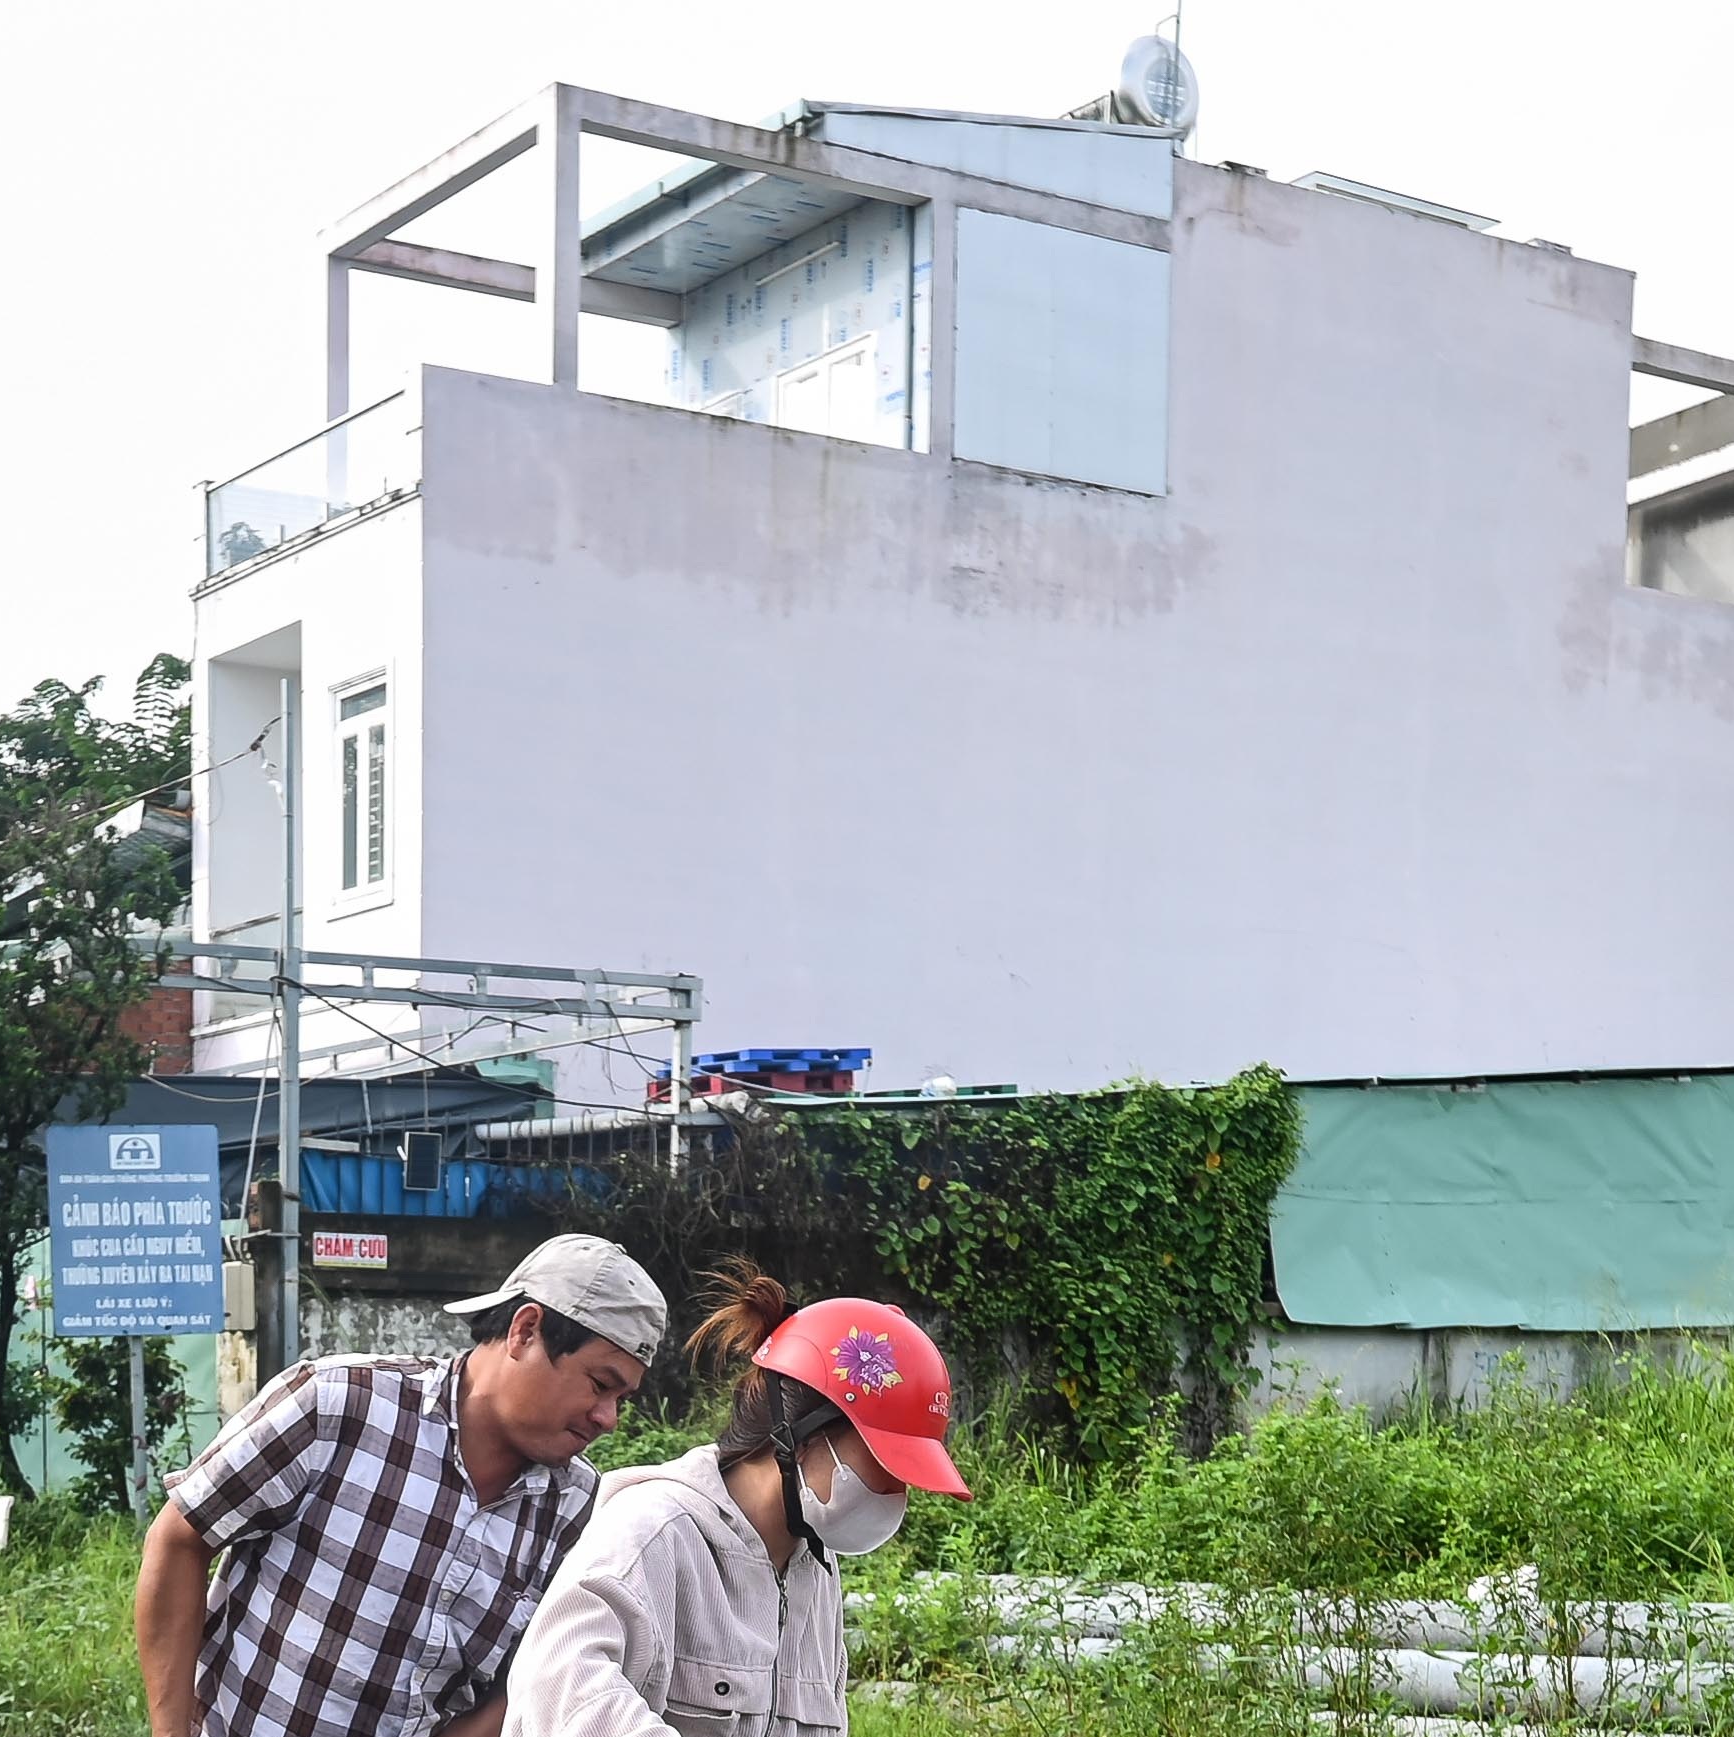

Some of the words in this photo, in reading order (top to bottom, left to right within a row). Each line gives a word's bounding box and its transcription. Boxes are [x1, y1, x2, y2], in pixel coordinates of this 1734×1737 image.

[62, 1194, 99, 1227] CẢNH
[102, 1196, 130, 1226] BÁO
[133, 1195, 165, 1226] PHÍA
[167, 1193, 212, 1225] TRƯỚC
[72, 1235, 99, 1258] KHÚC
[100, 1238, 122, 1256] CUA
[146, 1237, 173, 1255] NGUY
[175, 1229, 206, 1258] HIỂM,
[62, 1262, 100, 1286] THƯỜNG
[102, 1262, 135, 1285] XUYÊN
[137, 1259, 157, 1284] XẢY
[158, 1265, 173, 1283] RA
[174, 1264, 191, 1283] TAI
[192, 1264, 213, 1286] NẠN
[95, 1296, 115, 1309] LÁI
[117, 1299, 132, 1308] XE
[135, 1297, 157, 1308] LƯU
[160, 1295, 173, 1308] Ý:
[62, 1313, 92, 1327] GIẢM
[95, 1312, 118, 1326] TỐC
[119, 1313, 137, 1328] ĐỘ
[138, 1313, 155, 1326] VÀ
[156, 1315, 188, 1326] QUAN
[190, 1312, 212, 1325] SÁT
